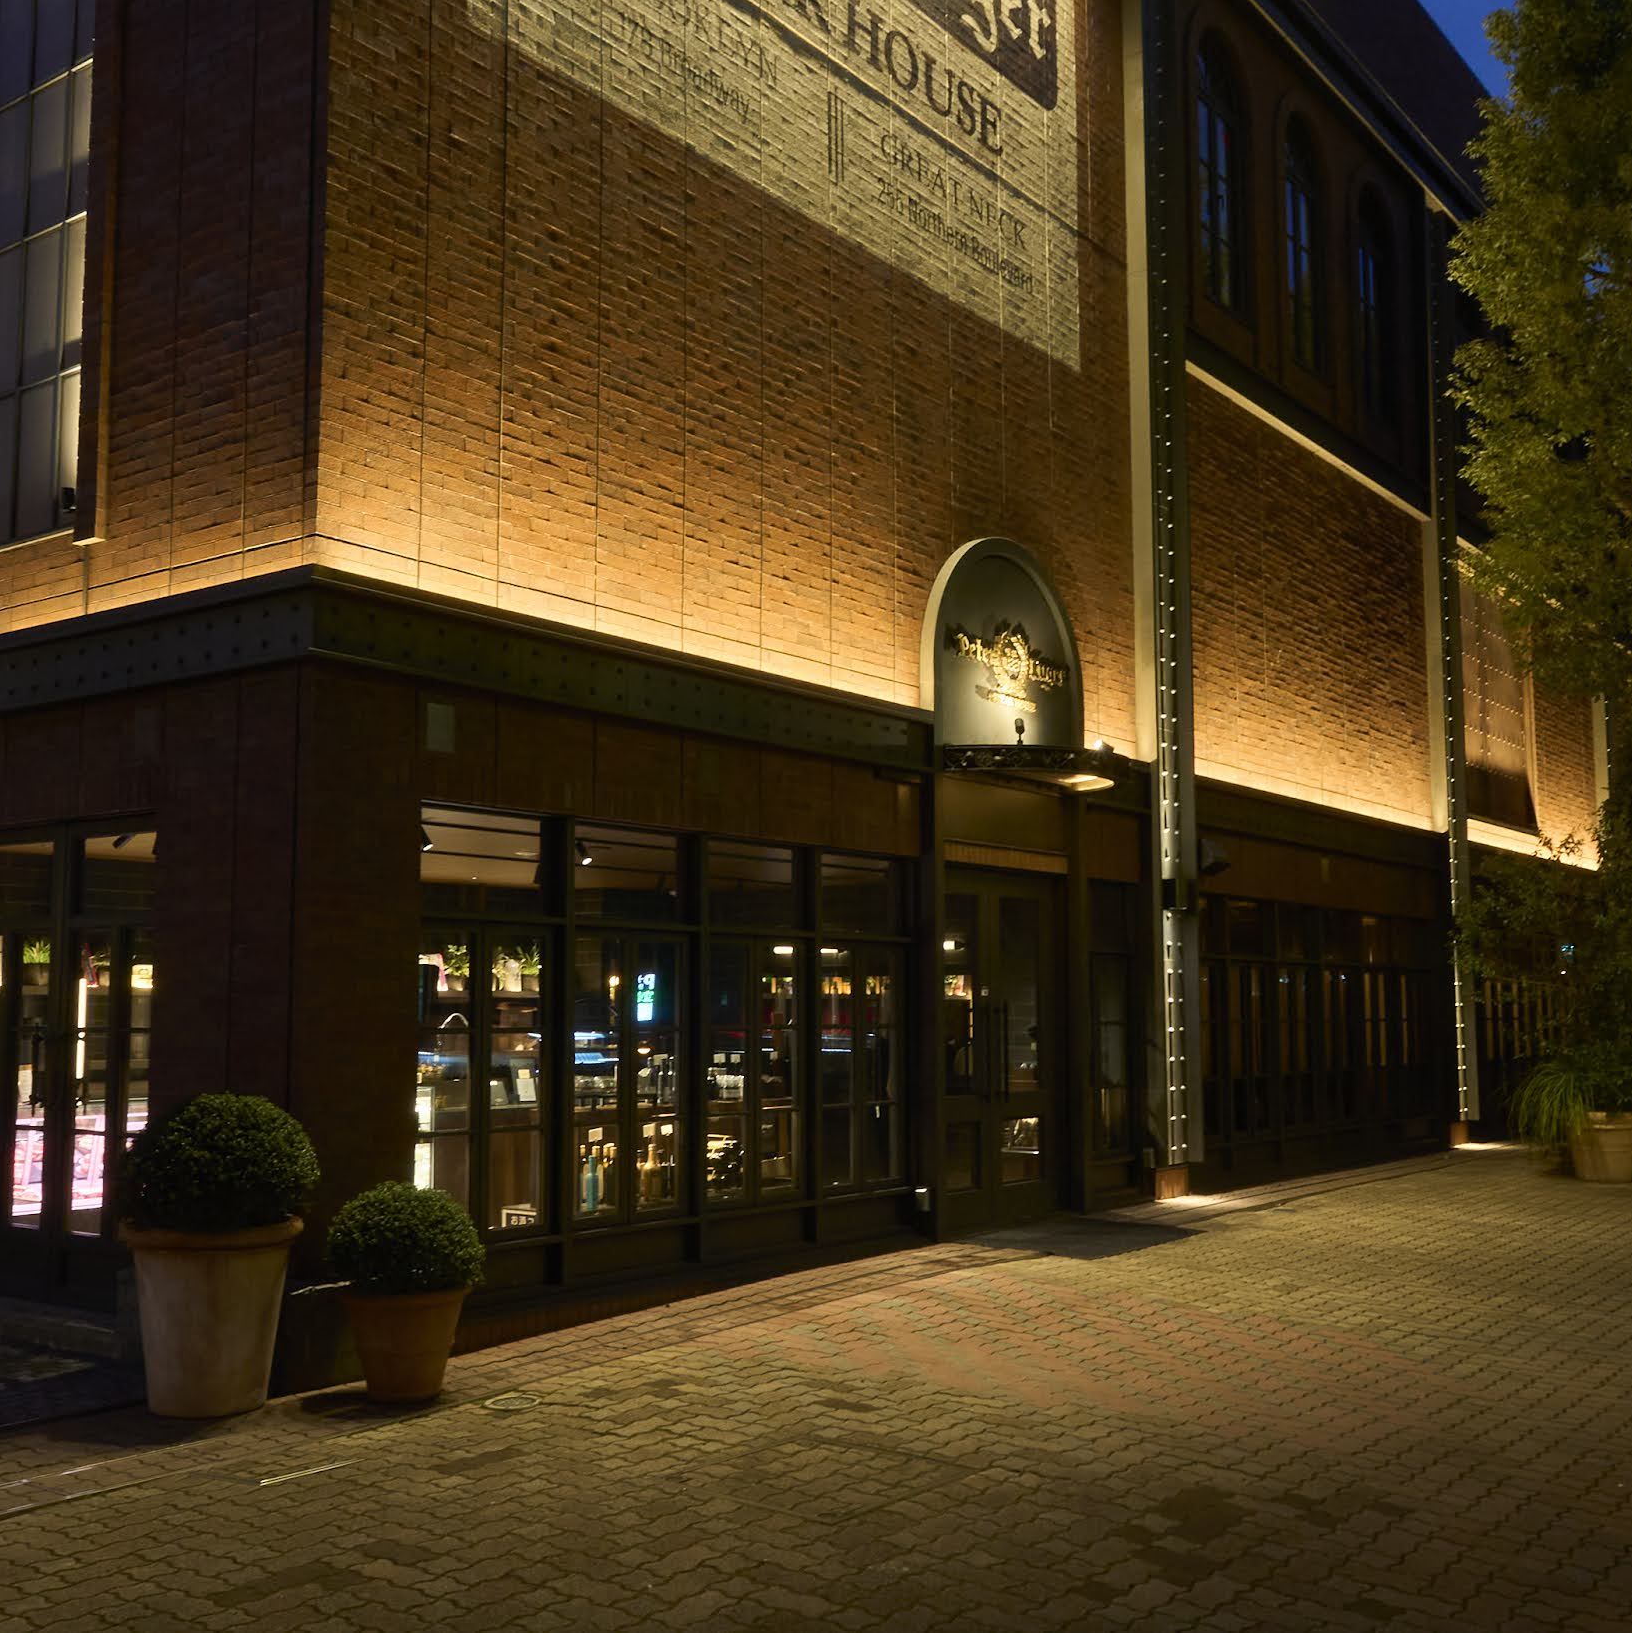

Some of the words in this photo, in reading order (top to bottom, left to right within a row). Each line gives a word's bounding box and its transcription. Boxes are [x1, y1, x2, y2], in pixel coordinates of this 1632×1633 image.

[880, 133, 960, 207] GREAT
[969, 191, 1026, 251] NECK
[908, 195, 966, 257] Northern
